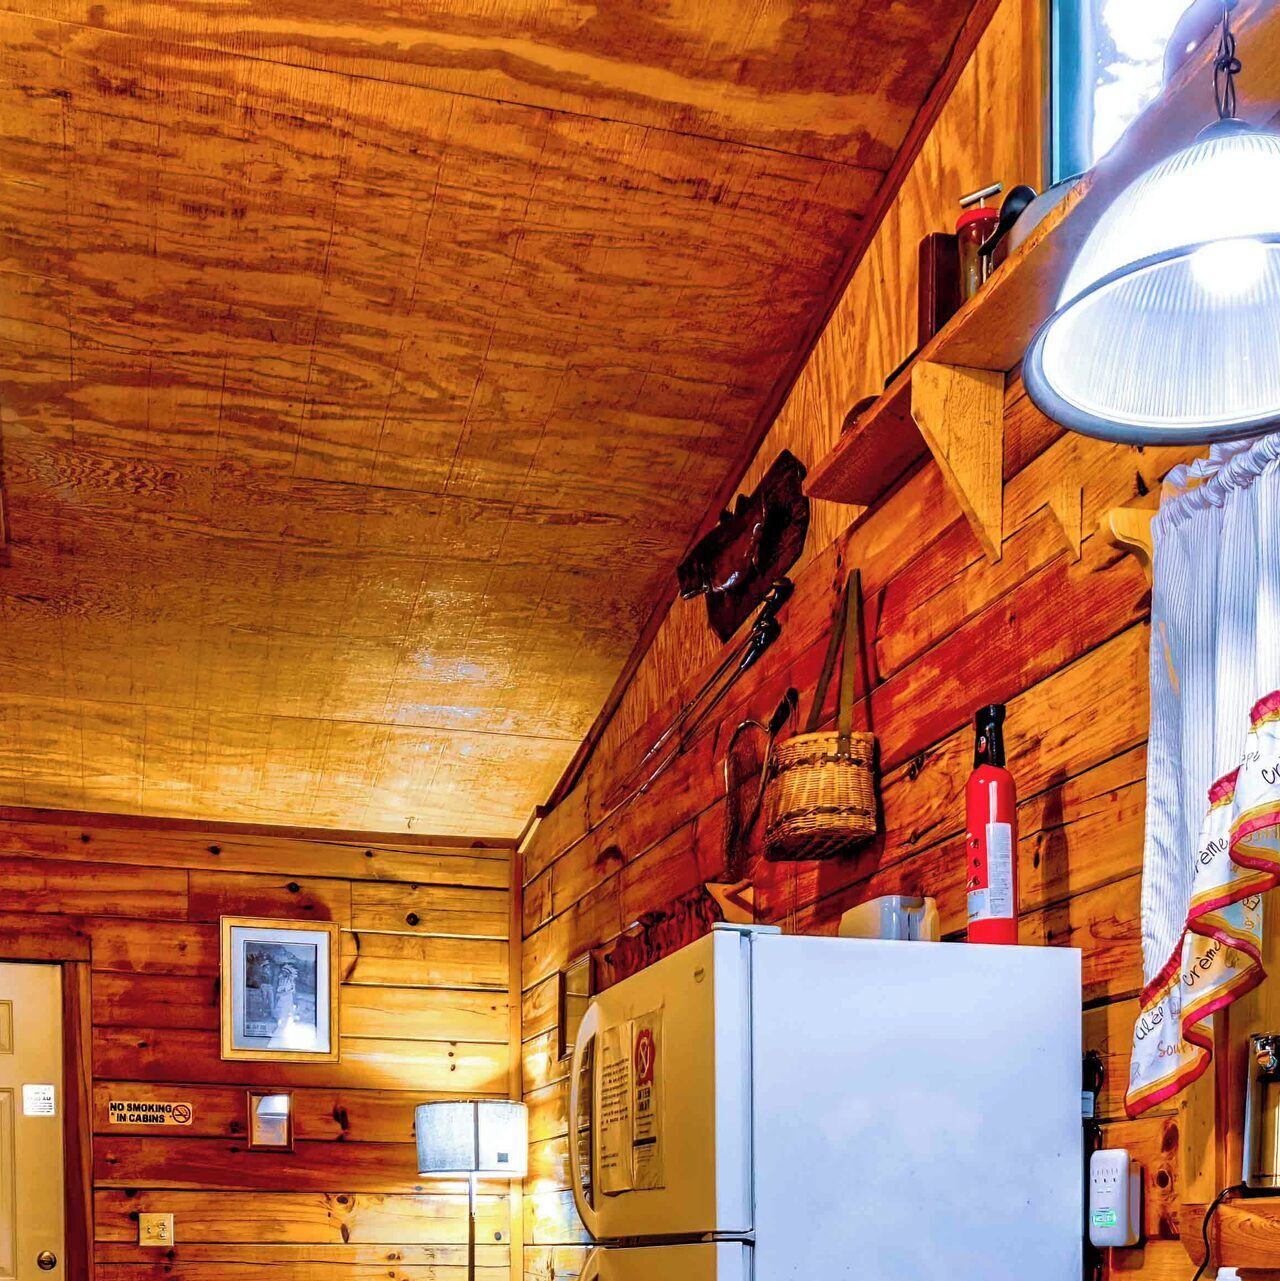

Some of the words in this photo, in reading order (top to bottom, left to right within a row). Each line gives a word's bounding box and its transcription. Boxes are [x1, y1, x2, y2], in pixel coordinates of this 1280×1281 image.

[110, 1103, 124, 1111] NO
[127, 1103, 172, 1113] SMOKING
[116, 1113, 126, 1122] IN
[129, 1114, 165, 1123] CABINS
